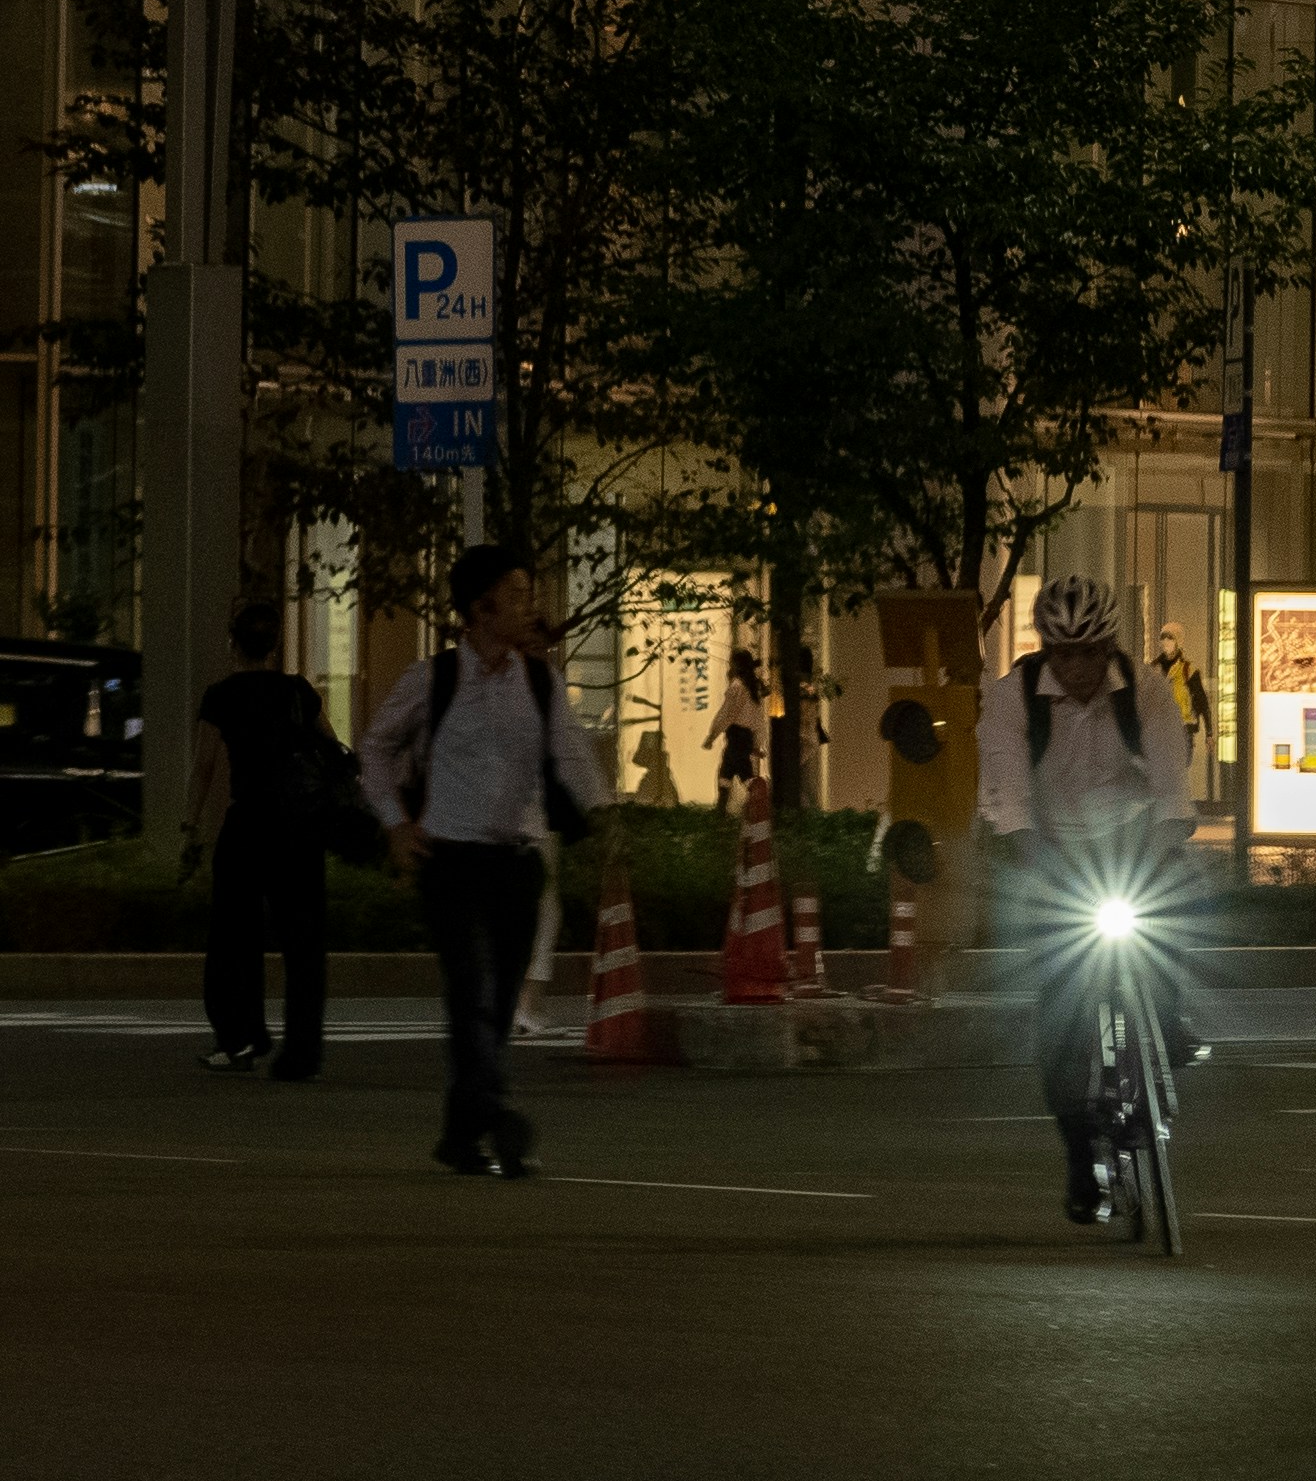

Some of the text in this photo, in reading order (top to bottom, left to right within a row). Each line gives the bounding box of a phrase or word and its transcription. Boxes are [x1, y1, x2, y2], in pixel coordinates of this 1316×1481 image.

[404, 240, 487, 319] P 24H
[452, 407, 484, 438] IN
